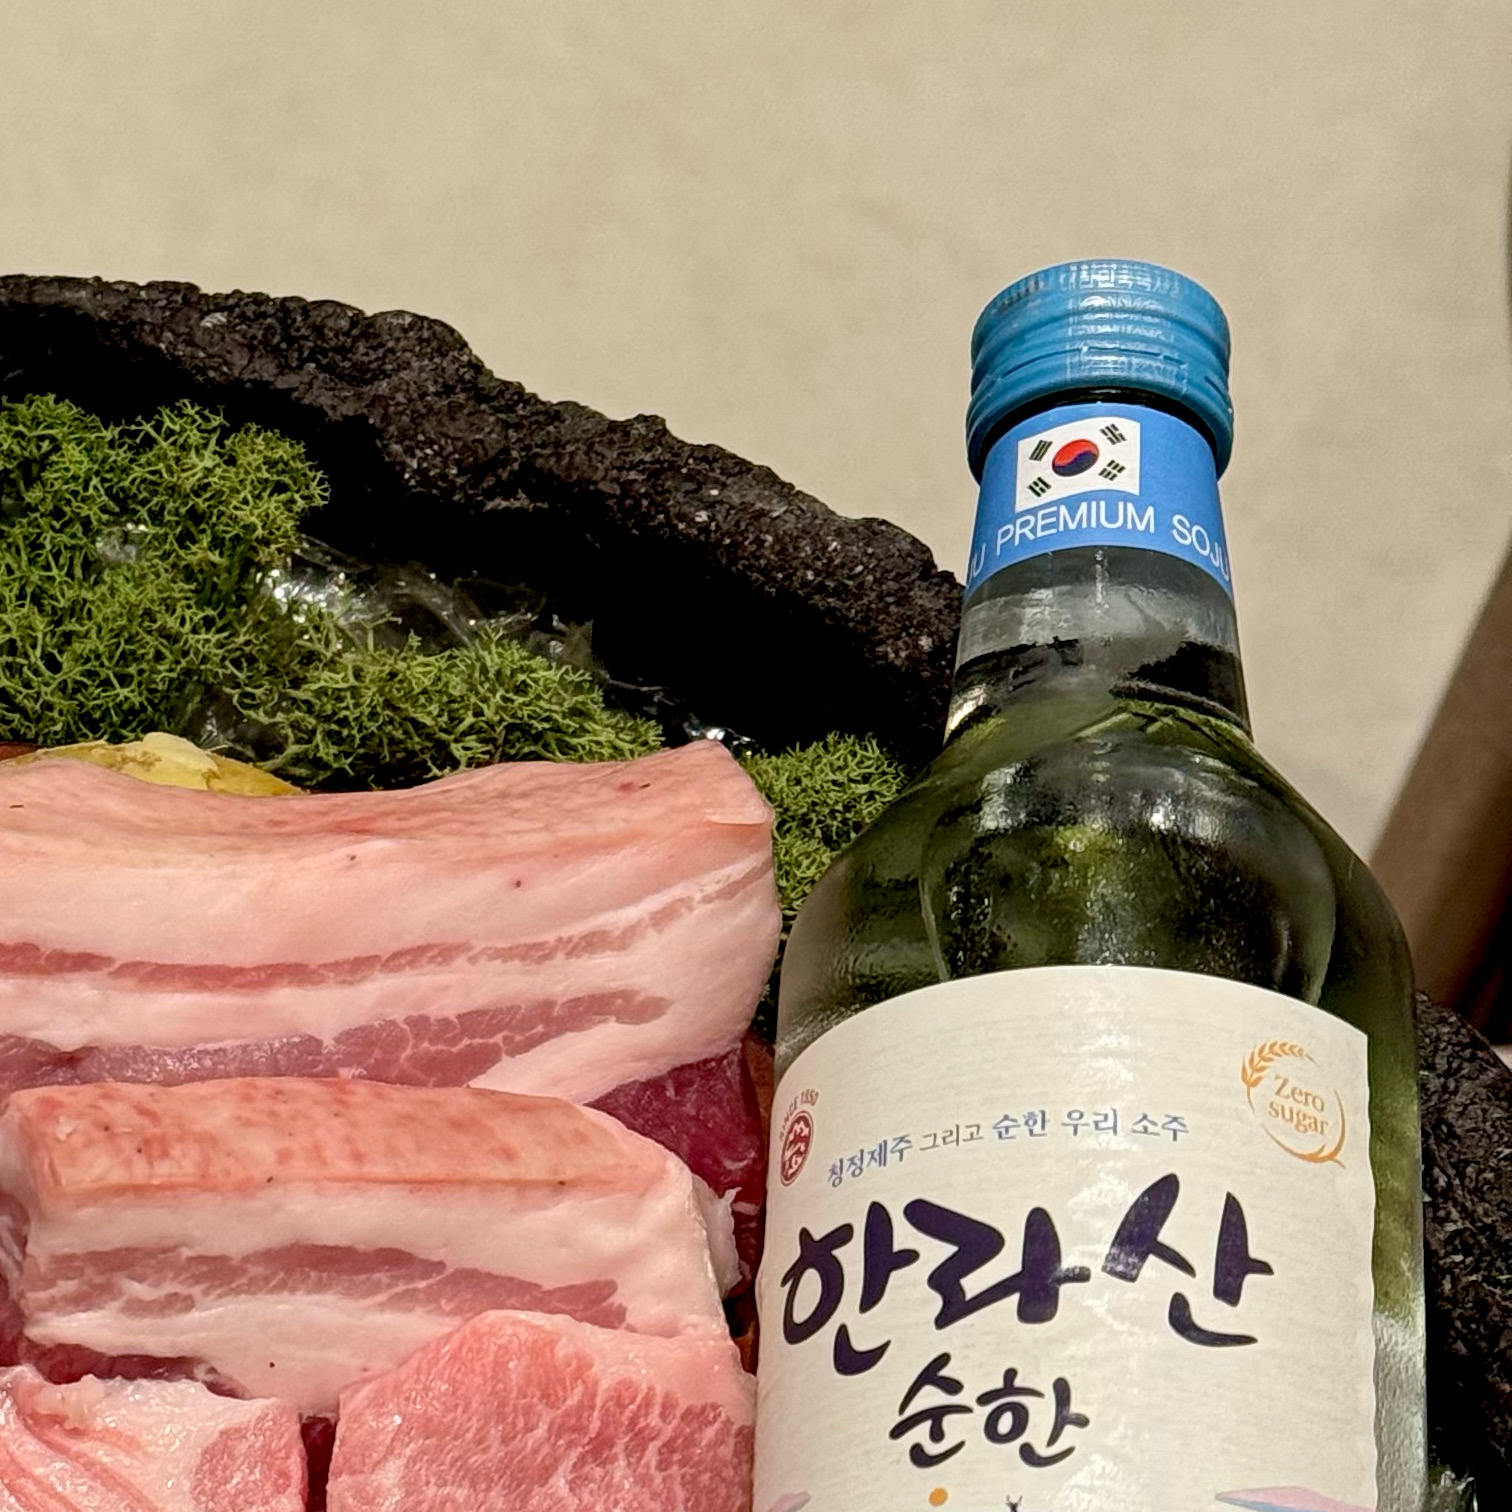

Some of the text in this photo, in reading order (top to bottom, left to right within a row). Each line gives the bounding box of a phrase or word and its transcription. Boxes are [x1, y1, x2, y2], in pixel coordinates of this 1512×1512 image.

[996, 500, 1155, 556] PREMIUM
[1172, 514, 1230, 582] SOJU
[1268, 1100, 1329, 1137] sugar
[1274, 1073, 1325, 1113] Zero
[827, 1134, 913, 1188] 청정제주
[919, 1123, 984, 1151] 그리고
[992, 1109, 1050, 1140] 순한
[1061, 1107, 1118, 1136] 우리
[1131, 1112, 1190, 1143] 소주
[781, 1173, 1275, 1376] 한라산
[888, 1352, 1090, 1469] 순한
